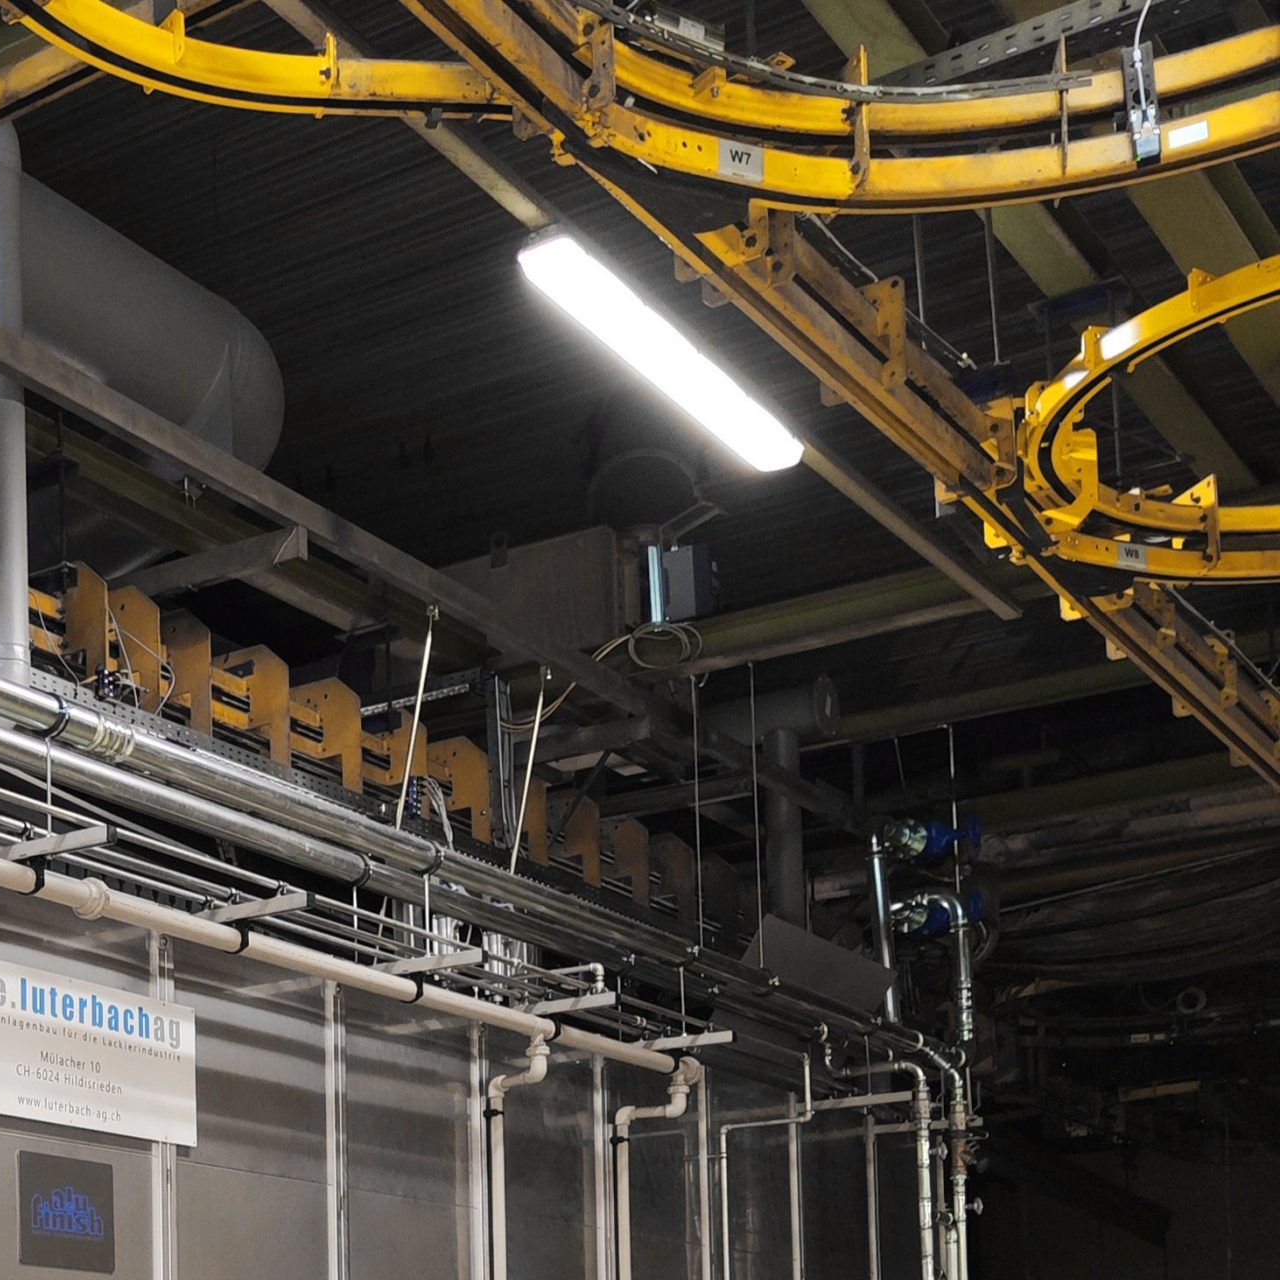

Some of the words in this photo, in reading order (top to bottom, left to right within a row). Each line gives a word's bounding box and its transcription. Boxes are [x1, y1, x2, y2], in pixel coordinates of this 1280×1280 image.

[729, 148, 751, 166] W7
[62, 1027, 77, 1040] für
[82, 1032, 98, 1044] die
[102, 1036, 181, 1063] Lackierindustrie
[40, 1050, 86, 1071] Mülacher
[90, 1061, 101, 1074] 10
[16, 1064, 60, 1083] CH-6024
[64, 1074, 123, 1096] Hildisrieden
